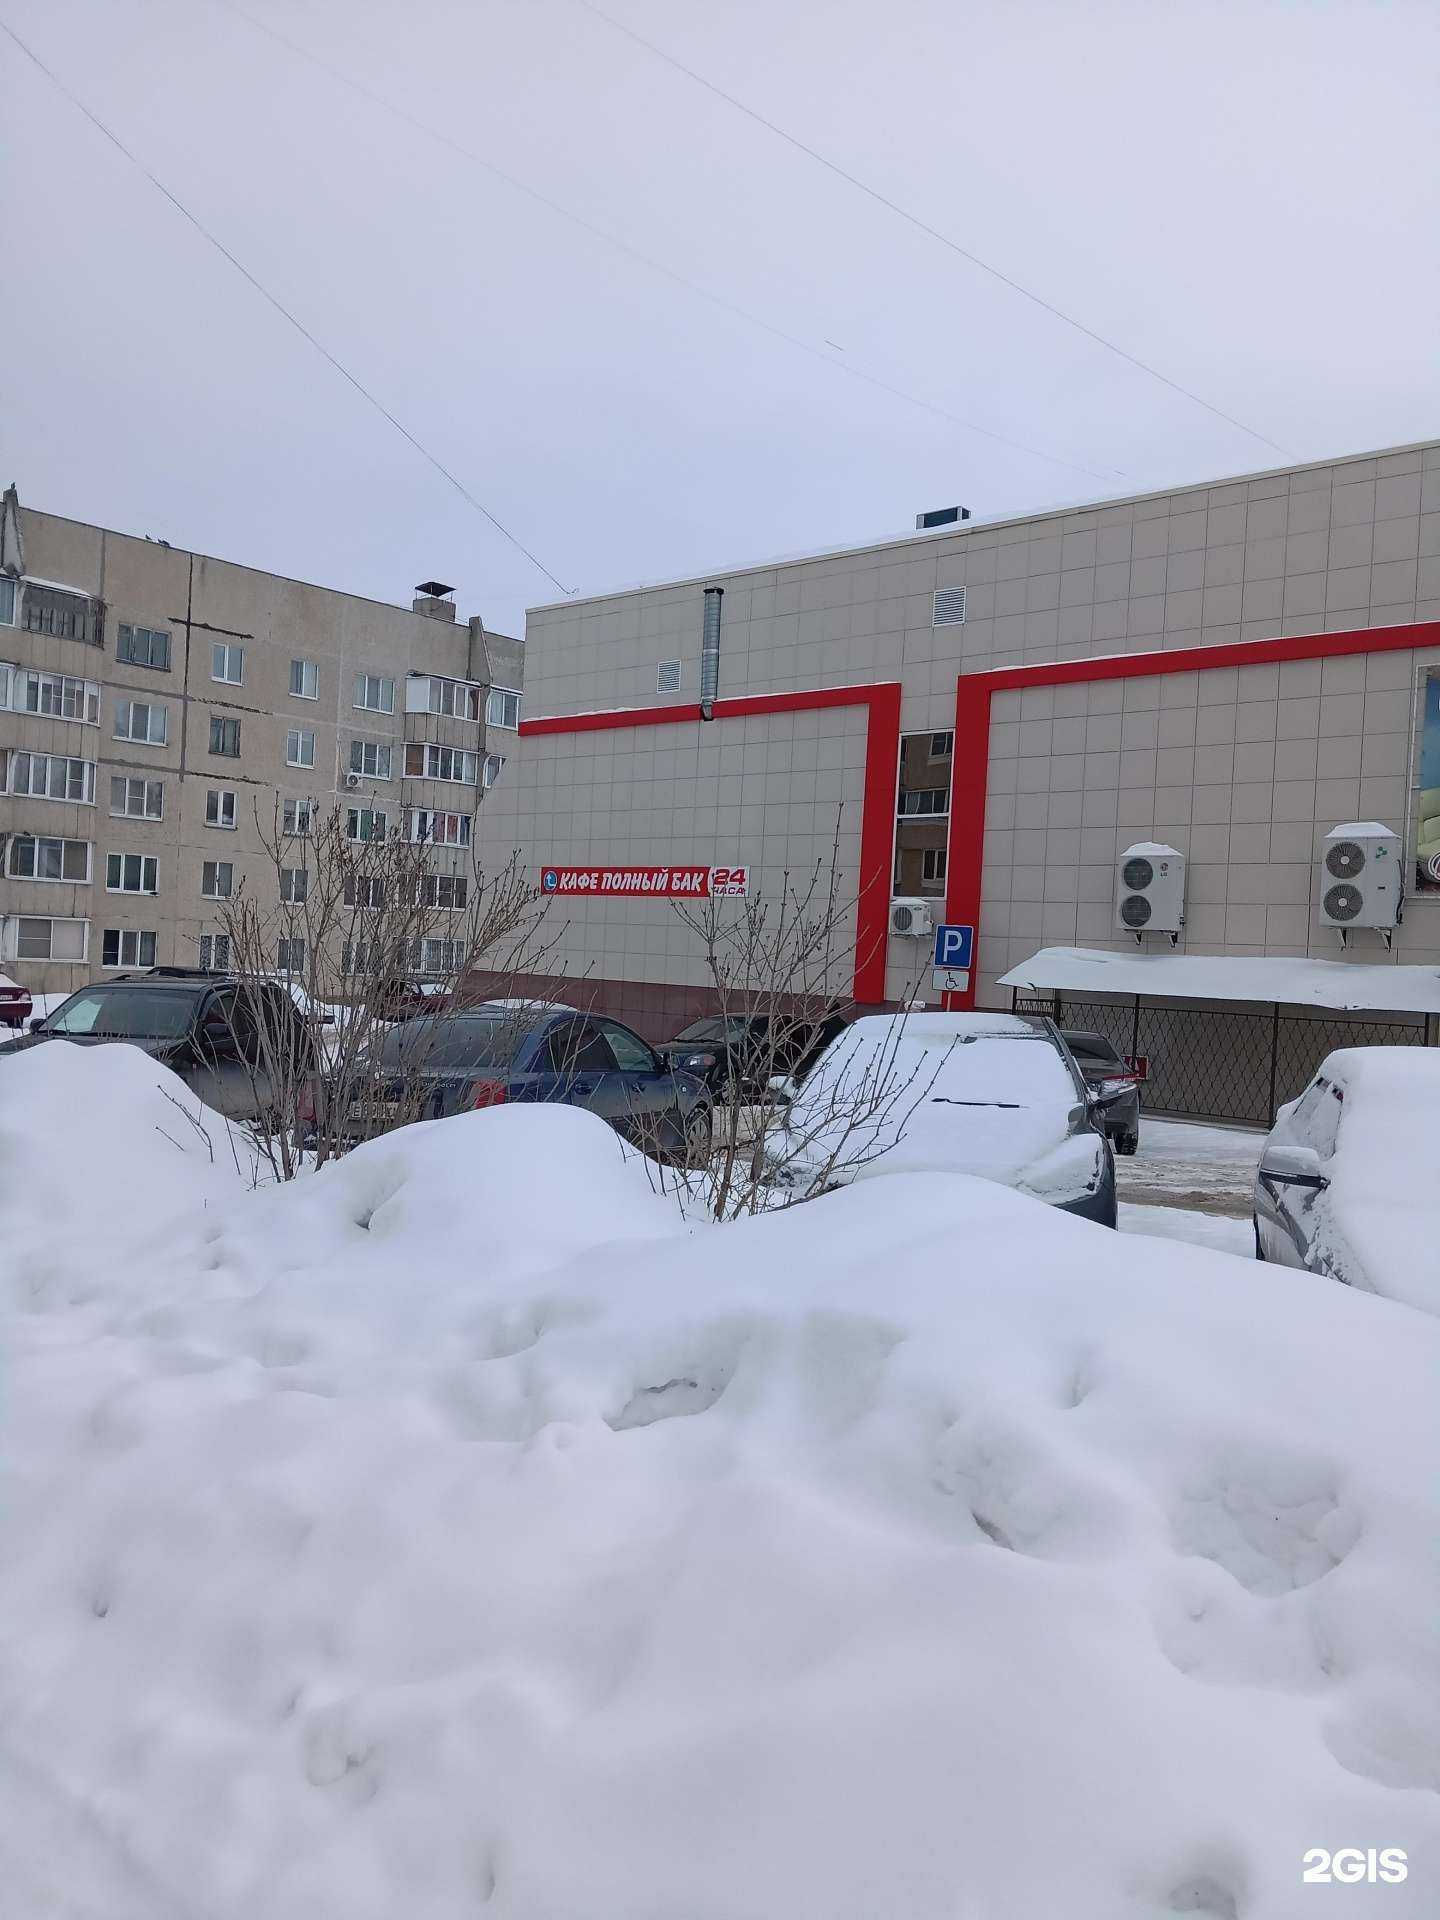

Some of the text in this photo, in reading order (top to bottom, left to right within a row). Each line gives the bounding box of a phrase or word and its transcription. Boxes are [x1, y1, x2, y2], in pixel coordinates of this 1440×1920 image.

[559, 868, 704, 892] КАФЕ ПОЛНЫЙ БАК
[714, 868, 746, 885] 24
[712, 887, 745, 895] ЧАСА
[943, 930, 963, 962] P
